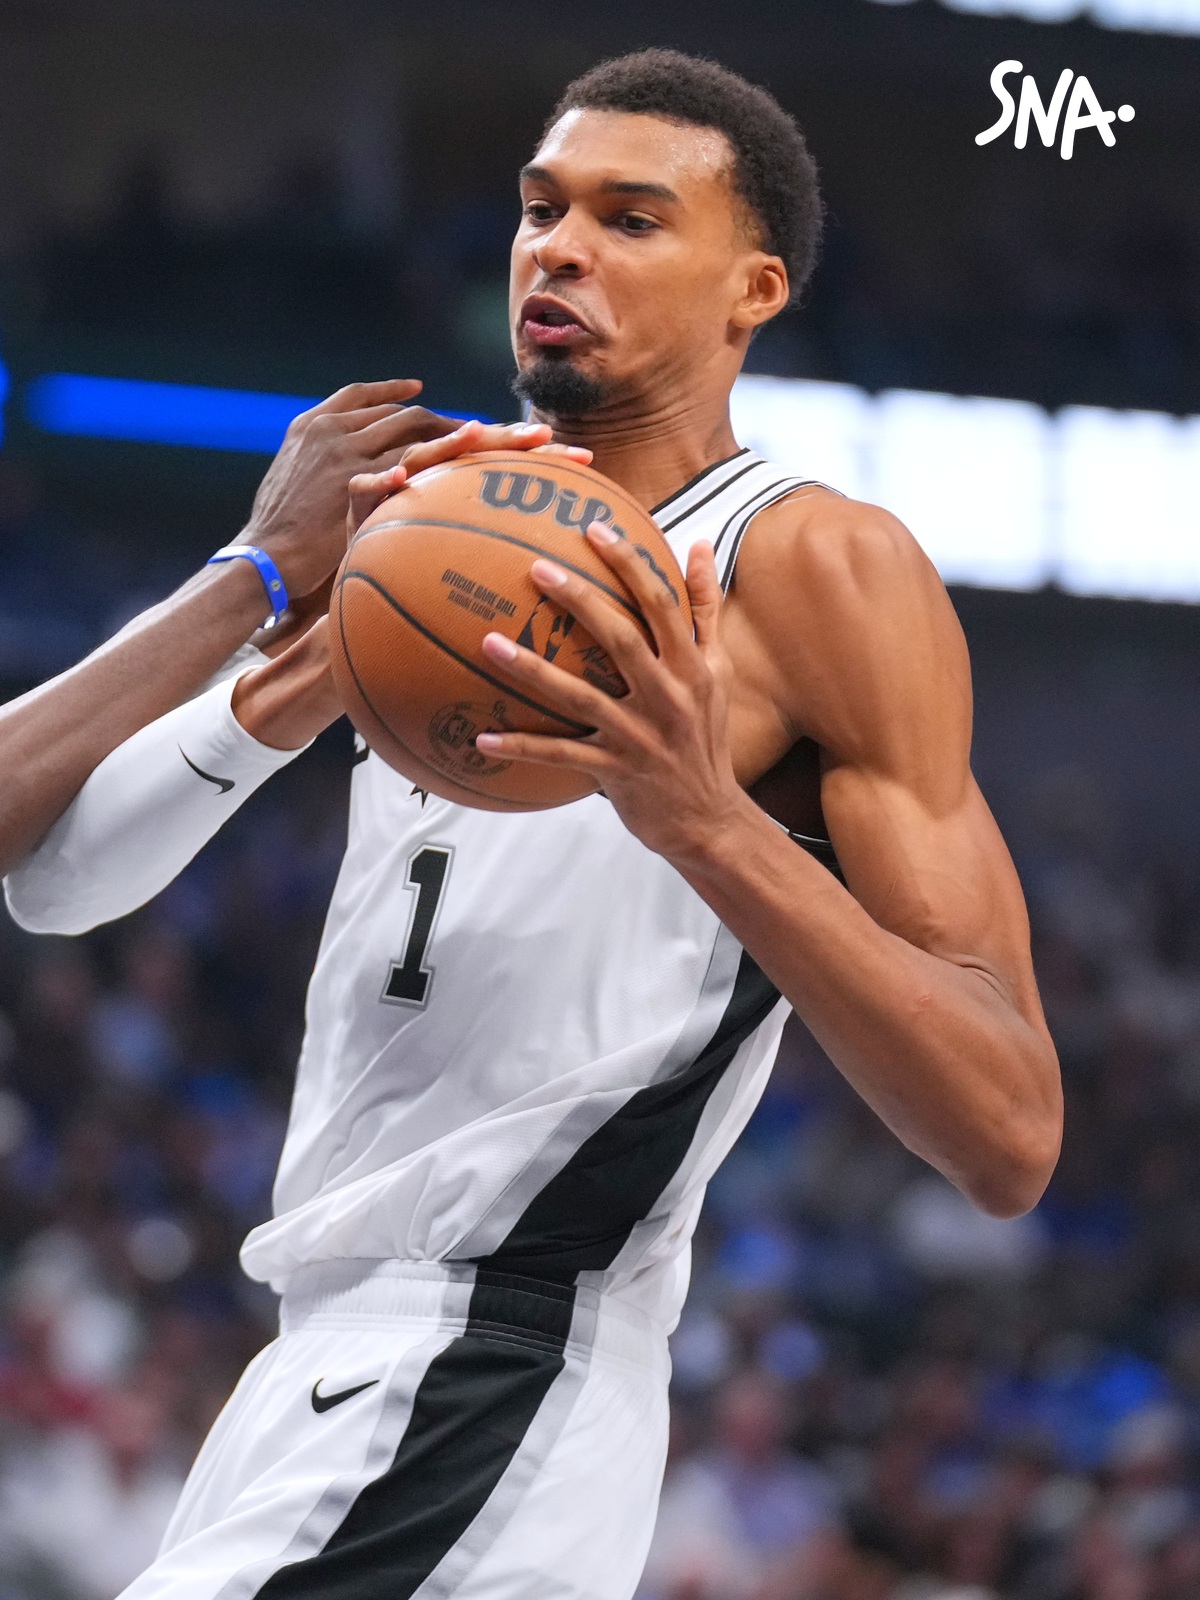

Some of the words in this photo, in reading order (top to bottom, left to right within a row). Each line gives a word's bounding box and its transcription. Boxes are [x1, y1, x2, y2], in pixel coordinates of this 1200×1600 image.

[441, 568, 476, 594] OFFICIAL
[496, 597, 517, 617] BALL
[379, 842, 456, 1011] 1
